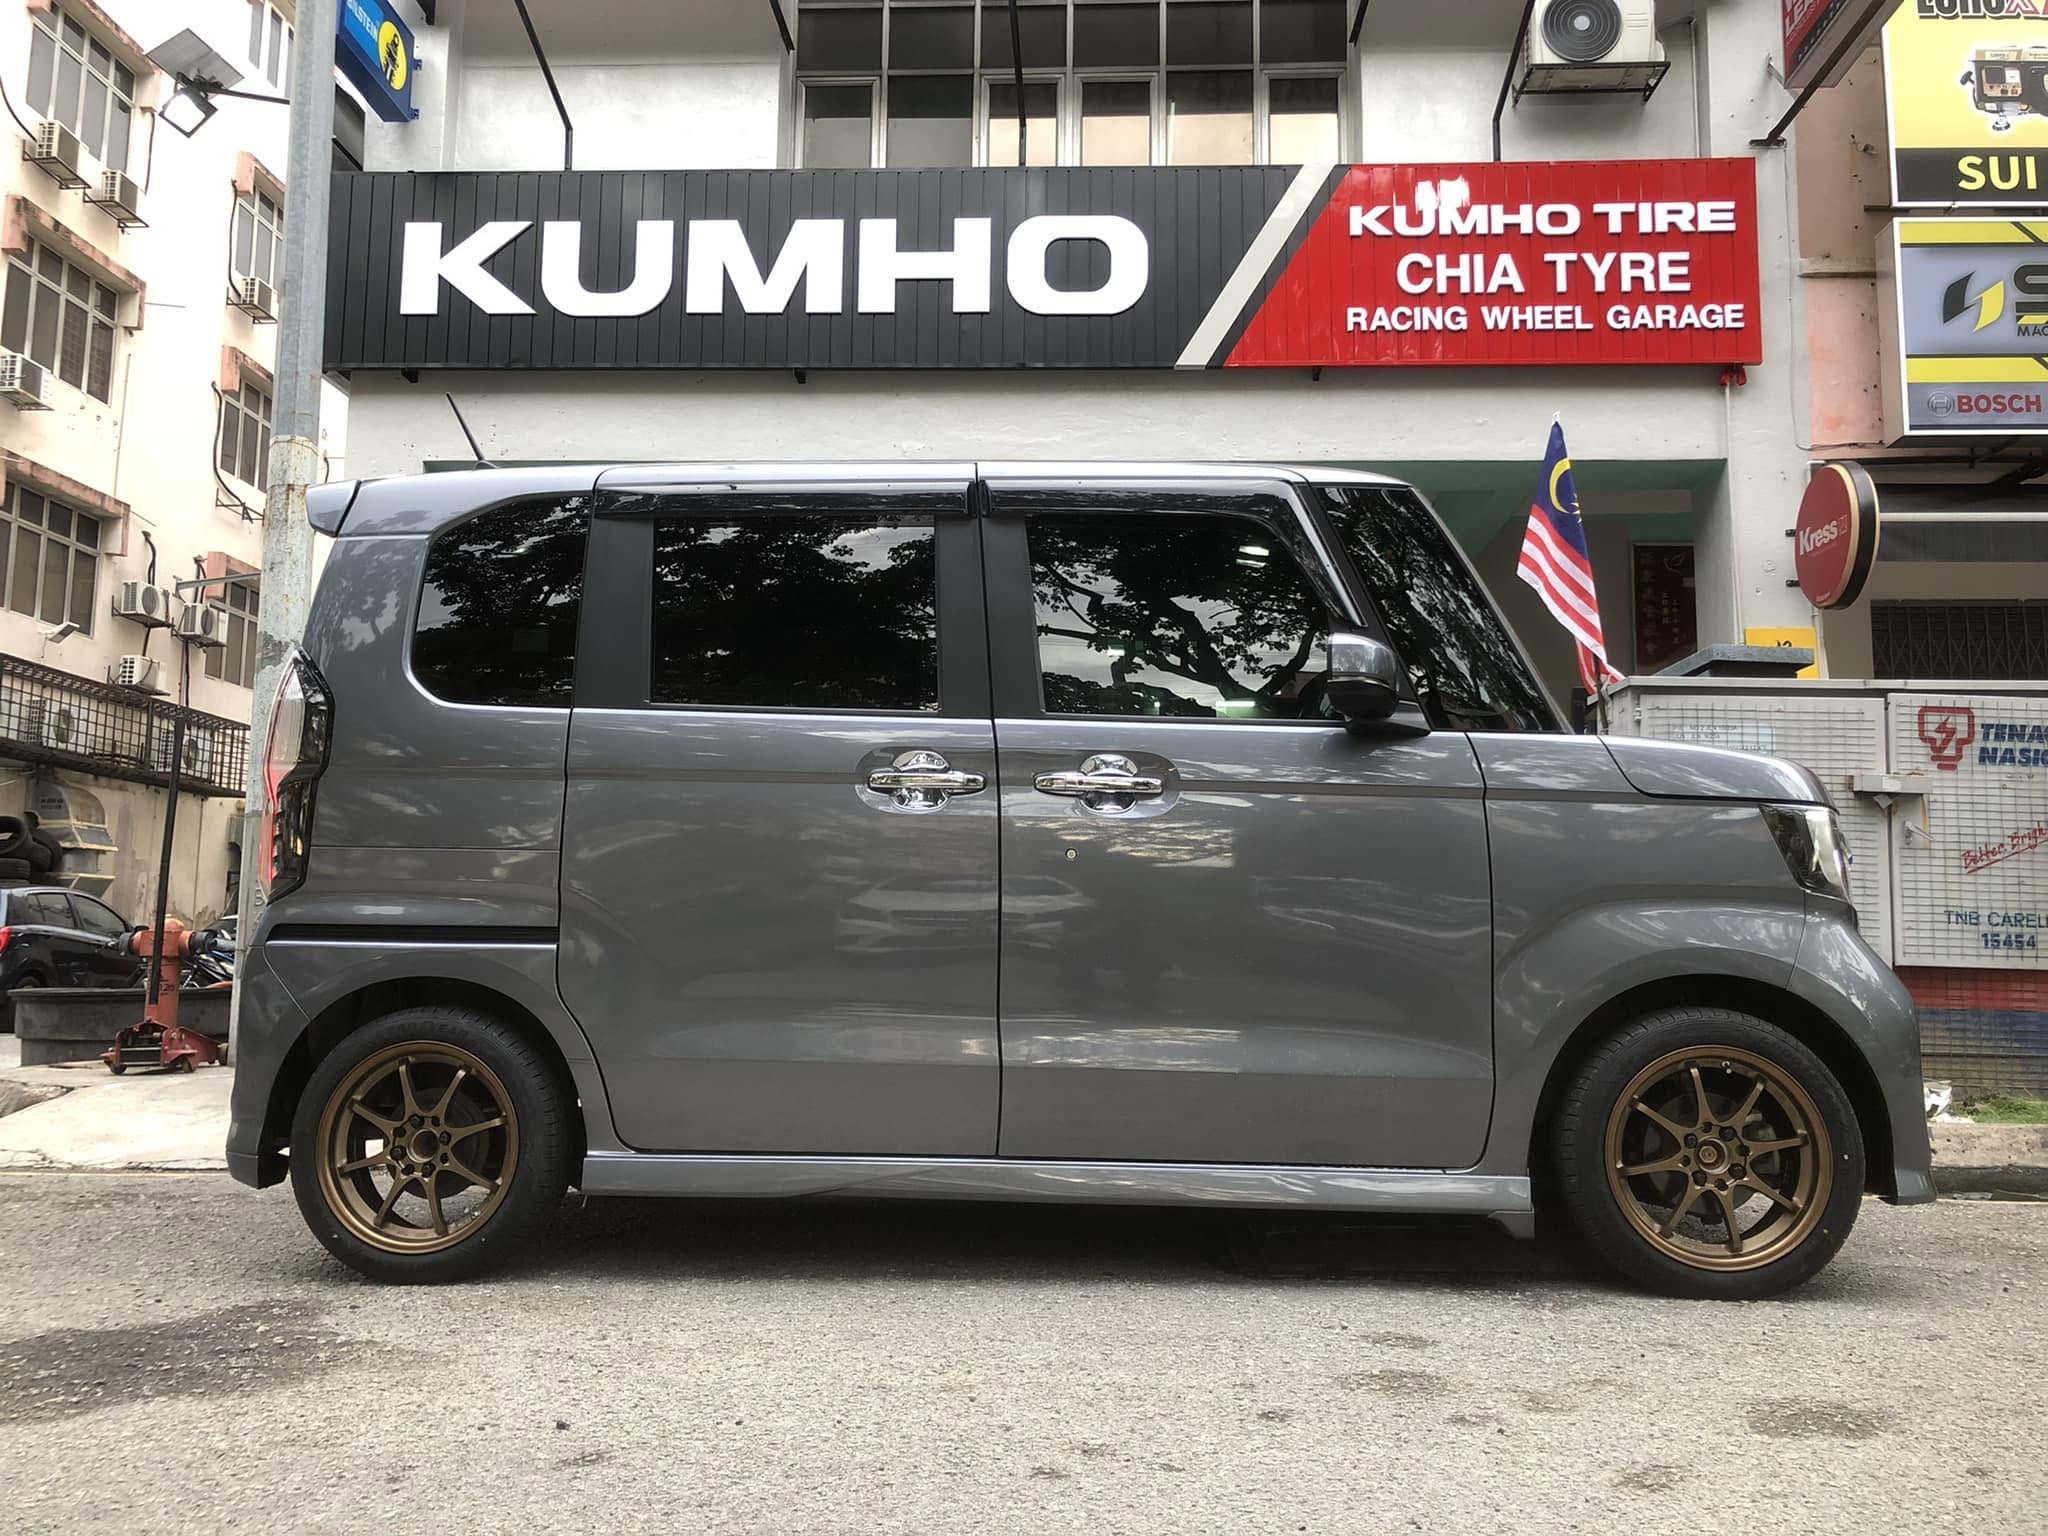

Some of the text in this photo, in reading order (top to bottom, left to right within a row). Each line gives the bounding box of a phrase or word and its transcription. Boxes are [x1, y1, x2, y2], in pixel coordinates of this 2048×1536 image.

[1957, 155, 2037, 190] SUI
[1349, 201, 1737, 236] KUMHO TIRE
[400, 215, 1149, 316] KUMHO
[1396, 251, 1692, 295] CHIA TYRE
[1346, 304, 1745, 332] RACING WHEEL GARAGE
[1957, 394, 2042, 414] BOSCH
[1799, 520, 1839, 555] Kress
[1944, 910, 1980, 926] TNB
[1981, 933, 2037, 950] 15454
